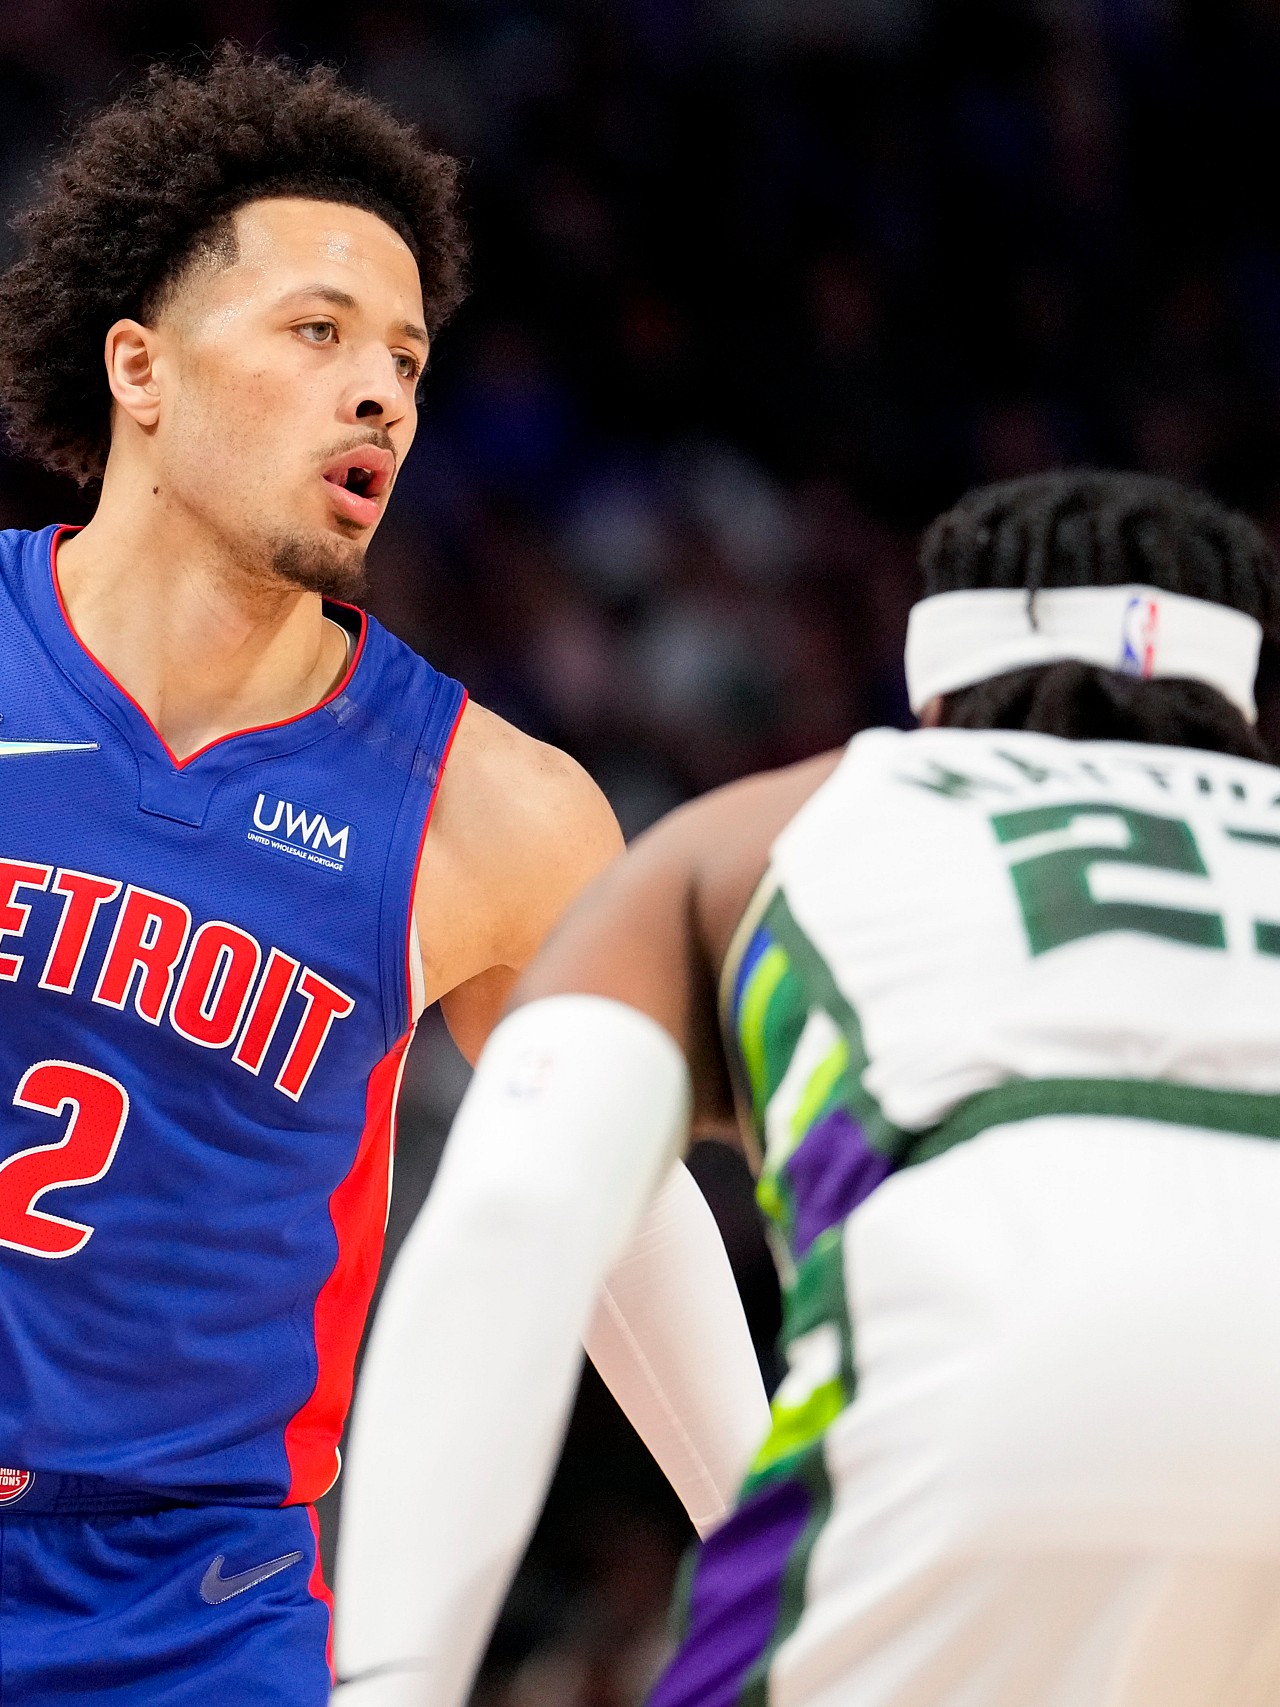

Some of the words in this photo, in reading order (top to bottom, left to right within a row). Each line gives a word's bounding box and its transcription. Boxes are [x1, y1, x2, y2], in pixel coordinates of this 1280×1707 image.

[247, 832, 270, 846] UNITED
[271, 840, 307, 859] WHOLESALE
[307, 854, 344, 872] MORTGAGE
[253, 793, 349, 859] UWM
[990, 802, 1280, 958] 2
